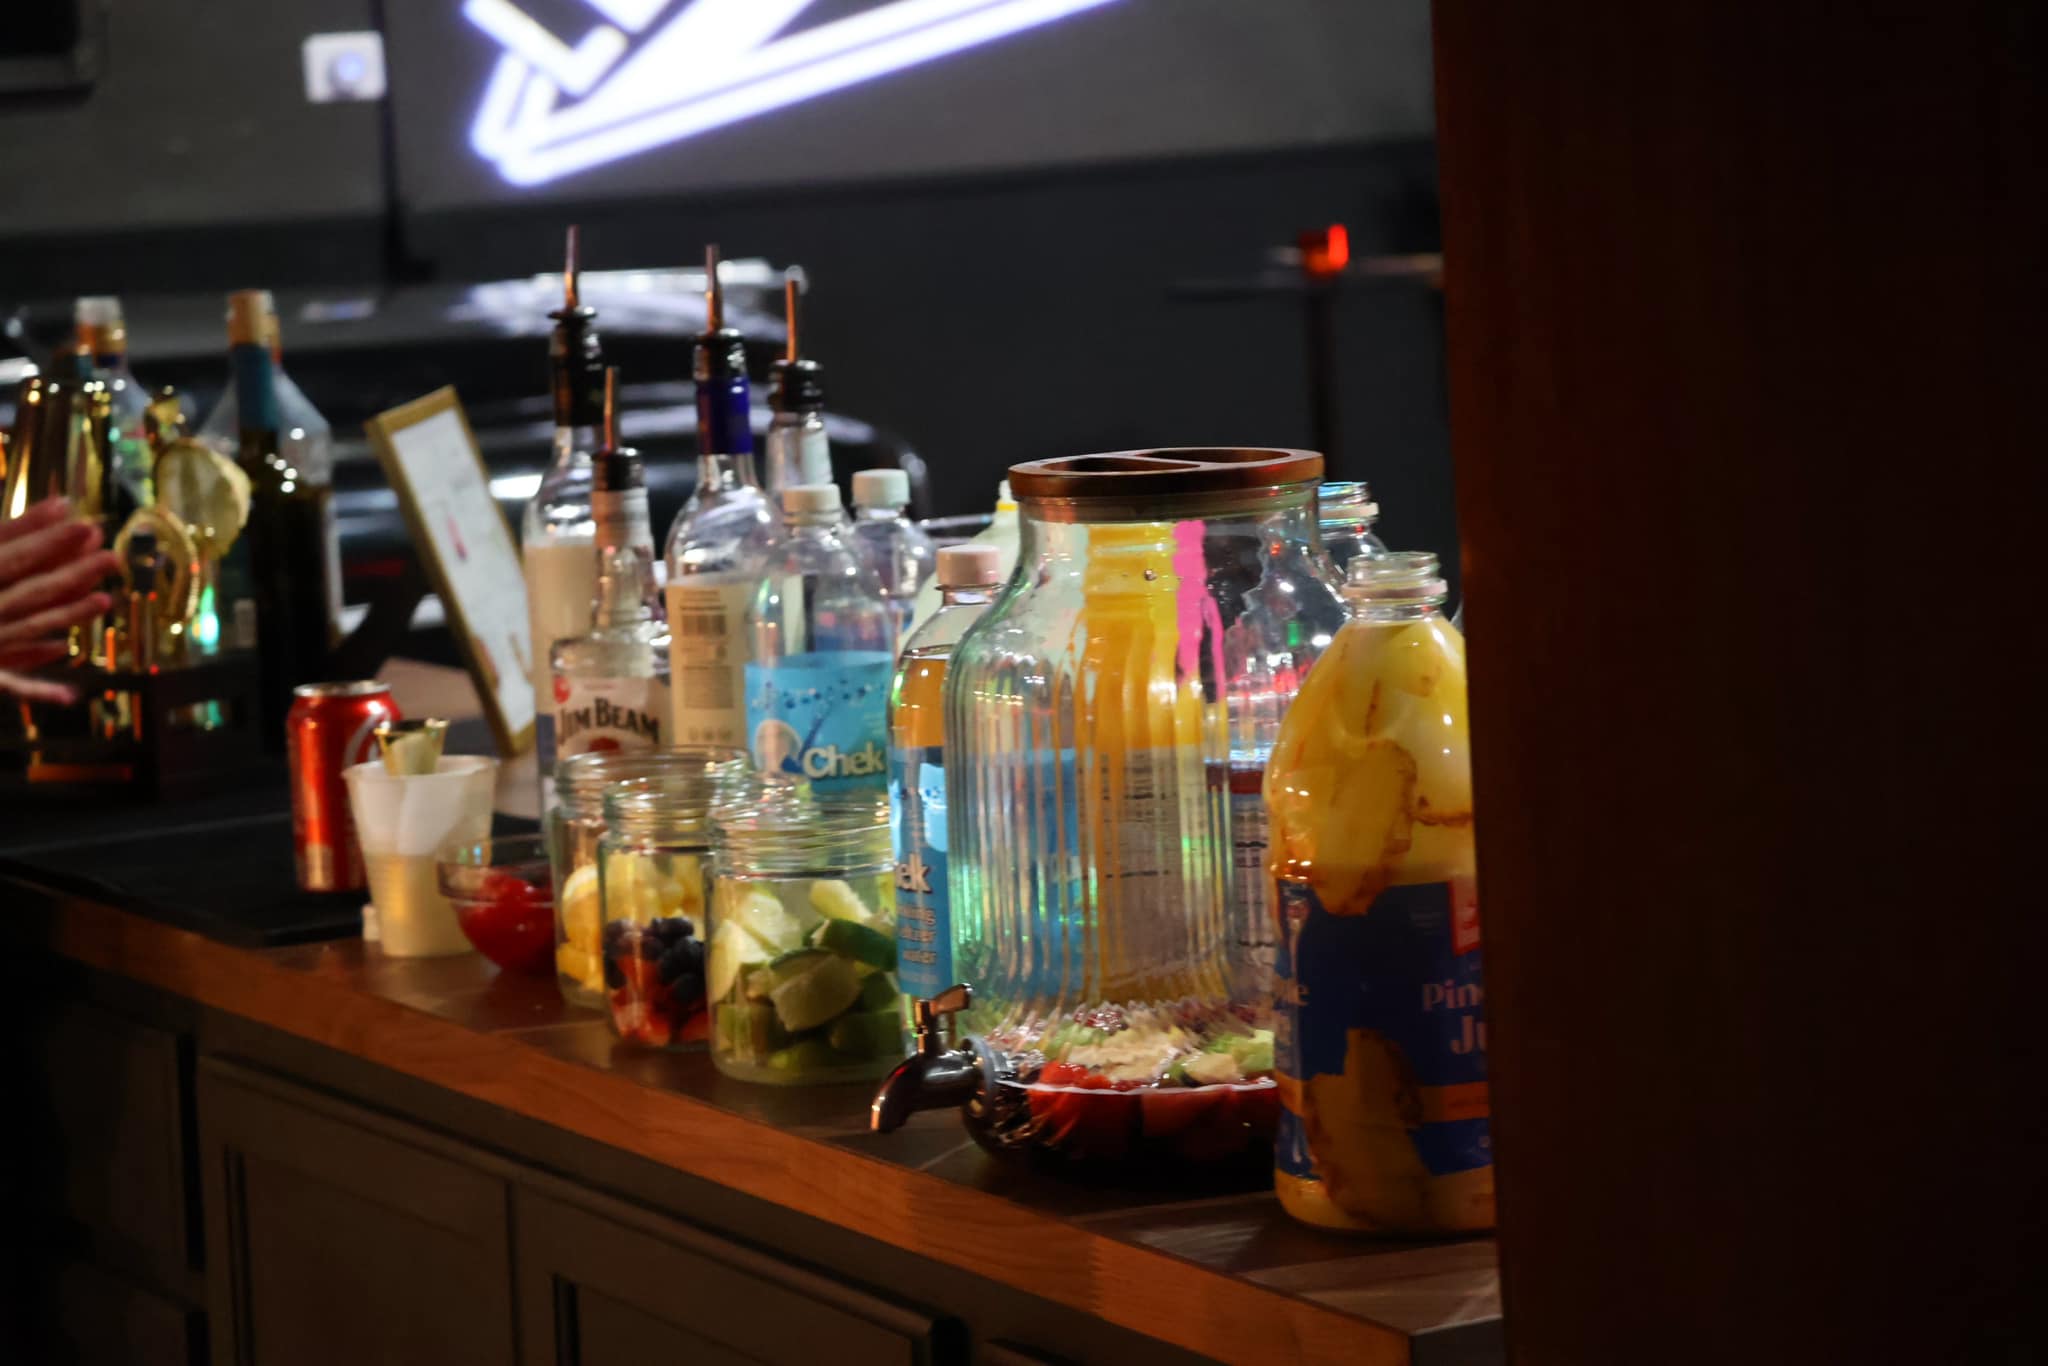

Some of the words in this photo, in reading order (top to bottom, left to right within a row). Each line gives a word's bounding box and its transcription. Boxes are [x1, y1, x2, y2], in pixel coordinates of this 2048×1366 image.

[557, 706, 591, 746] JIM
[593, 695, 660, 747] BEAM
[803, 741, 885, 778] Chek
[1421, 976, 1484, 1012] Pin
